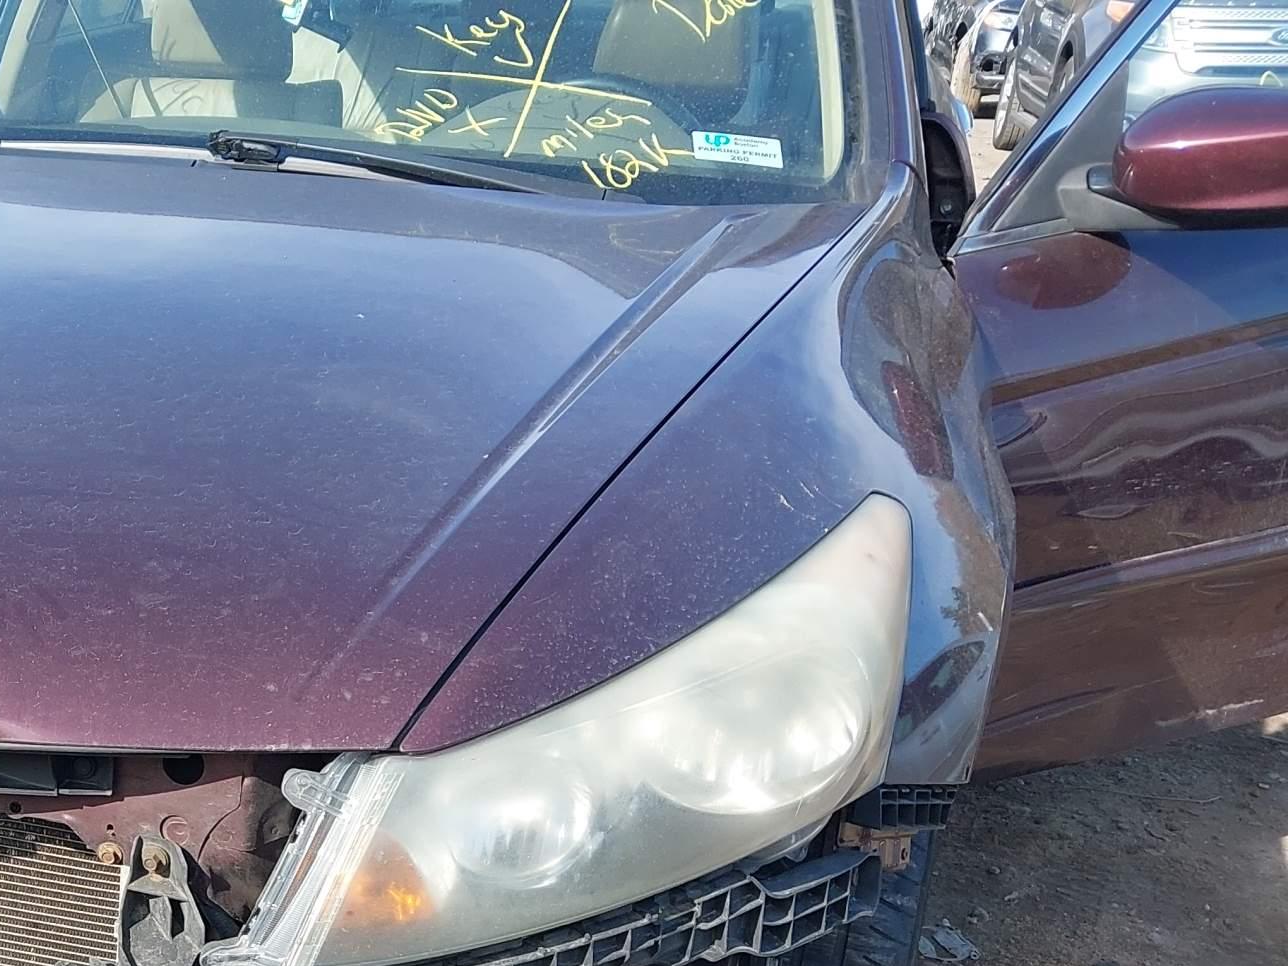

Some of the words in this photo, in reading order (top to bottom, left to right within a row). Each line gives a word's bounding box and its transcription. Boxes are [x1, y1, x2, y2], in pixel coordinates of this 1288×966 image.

[415, 9, 533, 67] Key
[698, 146, 740, 154] PARKING
[742, 150, 777, 159] PERMIT
